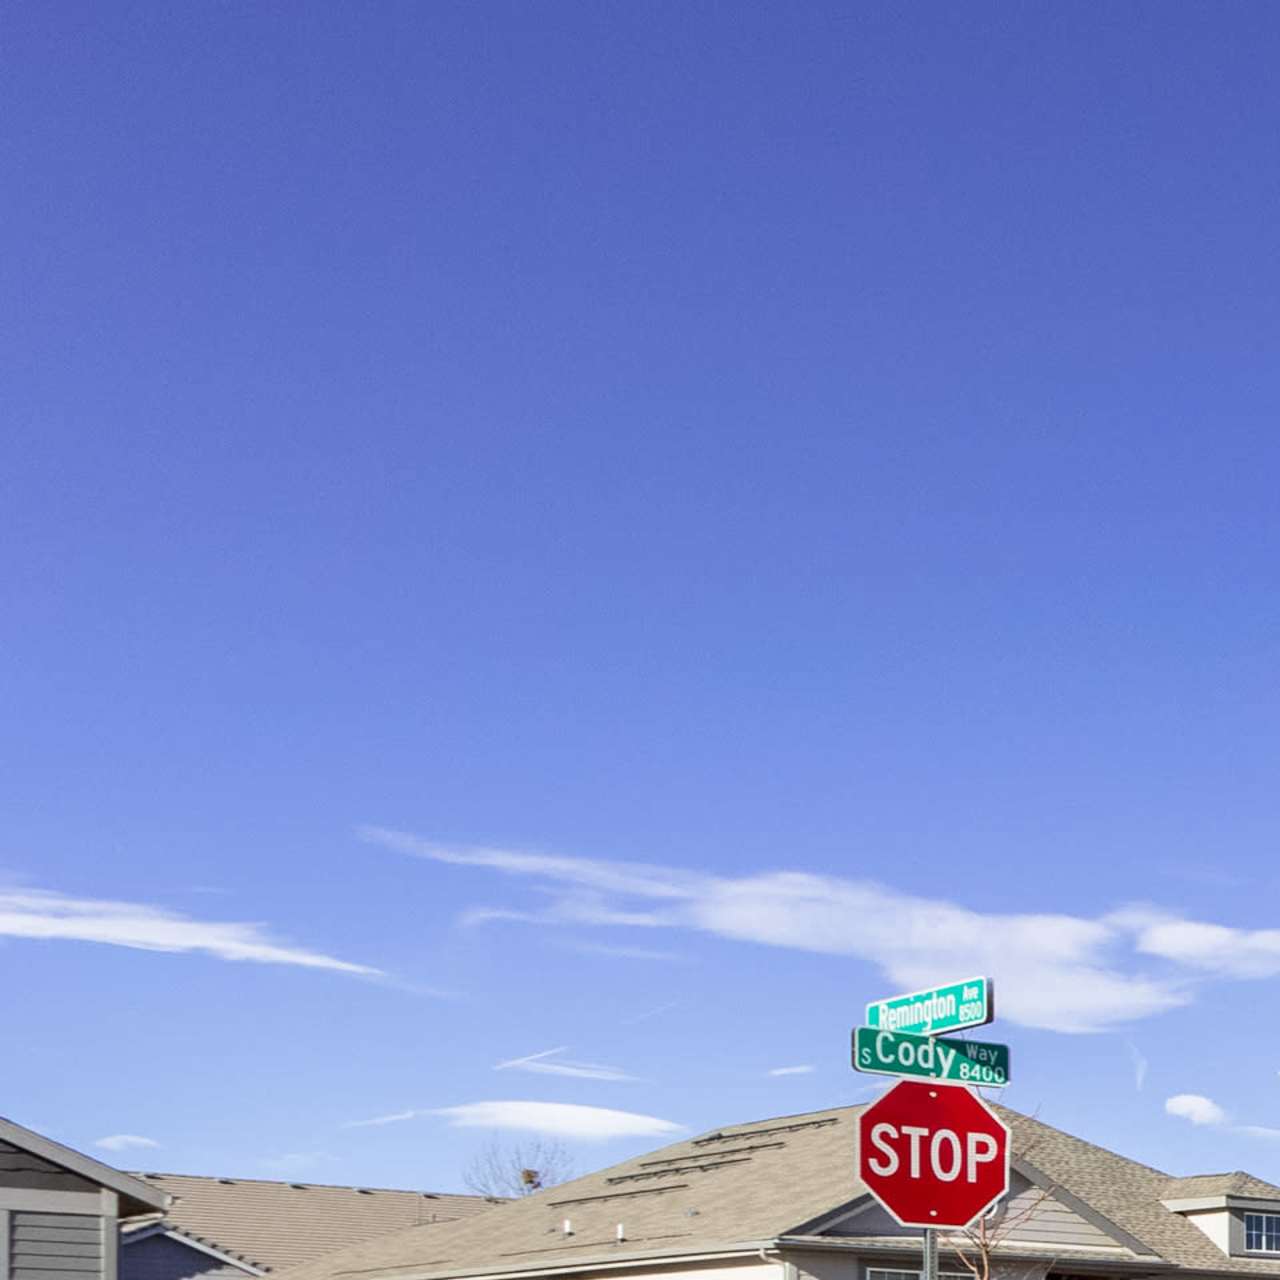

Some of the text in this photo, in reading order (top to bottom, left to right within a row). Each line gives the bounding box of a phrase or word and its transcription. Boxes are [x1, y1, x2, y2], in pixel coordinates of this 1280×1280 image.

[878, 986, 979, 1031] Remington Ave
[861, 1031, 999, 1079] S Cody Way
[959, 1063, 1005, 1083] 8400
[868, 1123, 998, 1183] STOP
